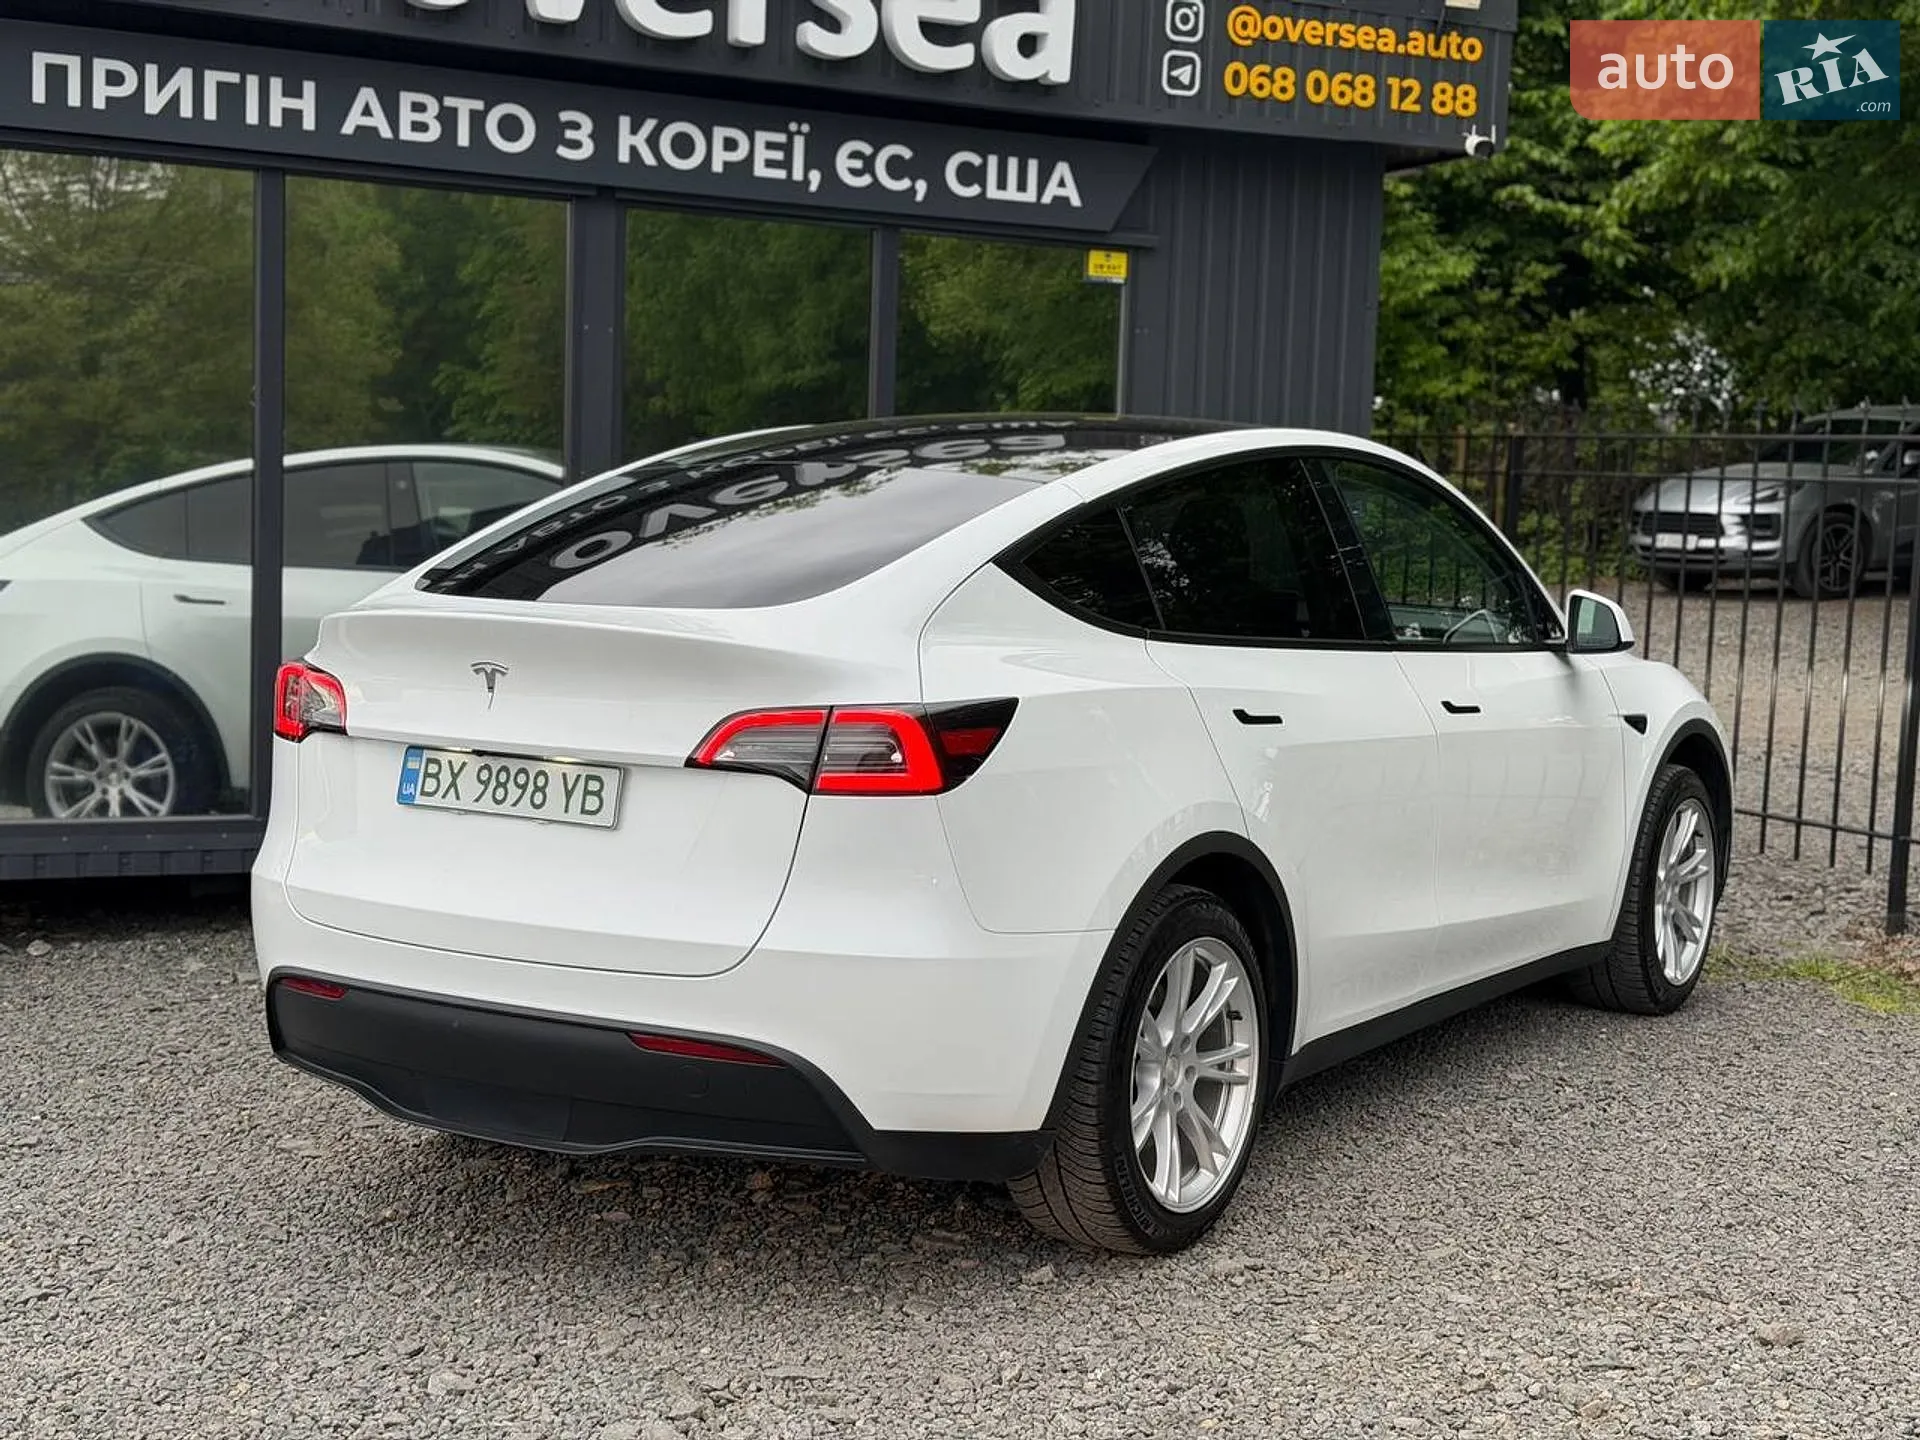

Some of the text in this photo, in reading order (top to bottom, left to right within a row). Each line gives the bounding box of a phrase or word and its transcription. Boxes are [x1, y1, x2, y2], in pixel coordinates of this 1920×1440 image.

[1226, 4, 1485, 63] @oversea.auto
[1223, 60, 1479, 118] 068 068 12 88
[31, 51, 1083, 207] ПРИГІН АВТО З КОРЕЇ, ЄС, США
[402, 783, 416, 796] UA
[419, 756, 606, 816] BX 9898 YB
